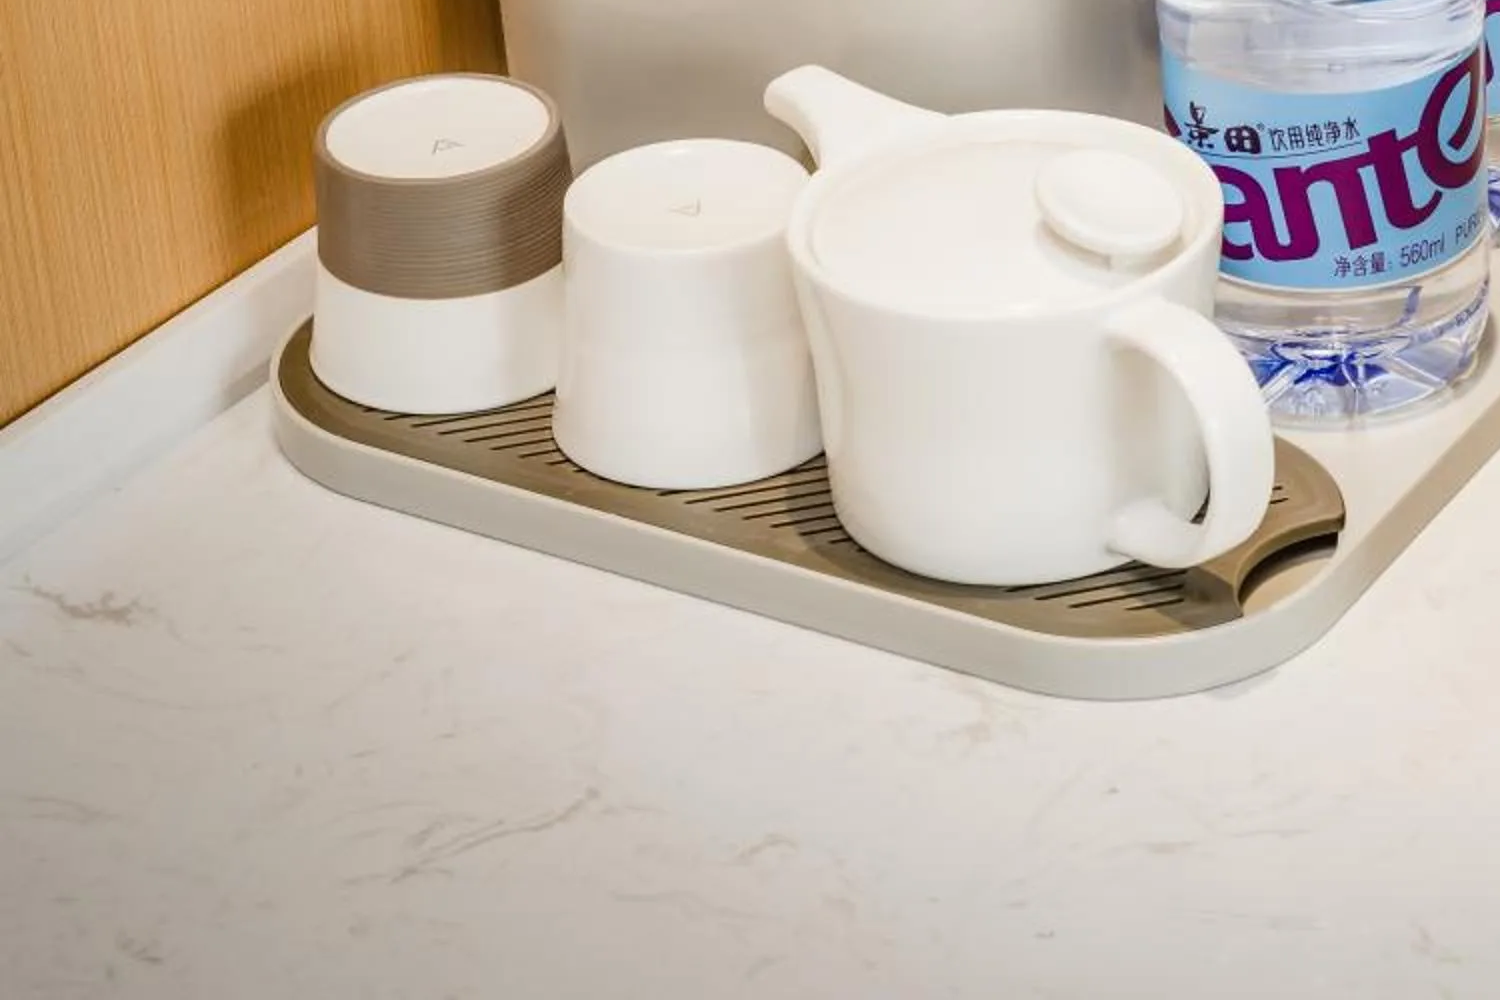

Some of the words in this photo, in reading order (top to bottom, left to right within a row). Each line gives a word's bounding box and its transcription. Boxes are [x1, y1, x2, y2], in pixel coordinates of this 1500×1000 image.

[1183, 100, 1262, 154] 景田
[1267, 115, 1361, 152] 饮用纯净水
[1164, 48, 1487, 263] ante
[1399, 231, 1445, 268] 560ml
